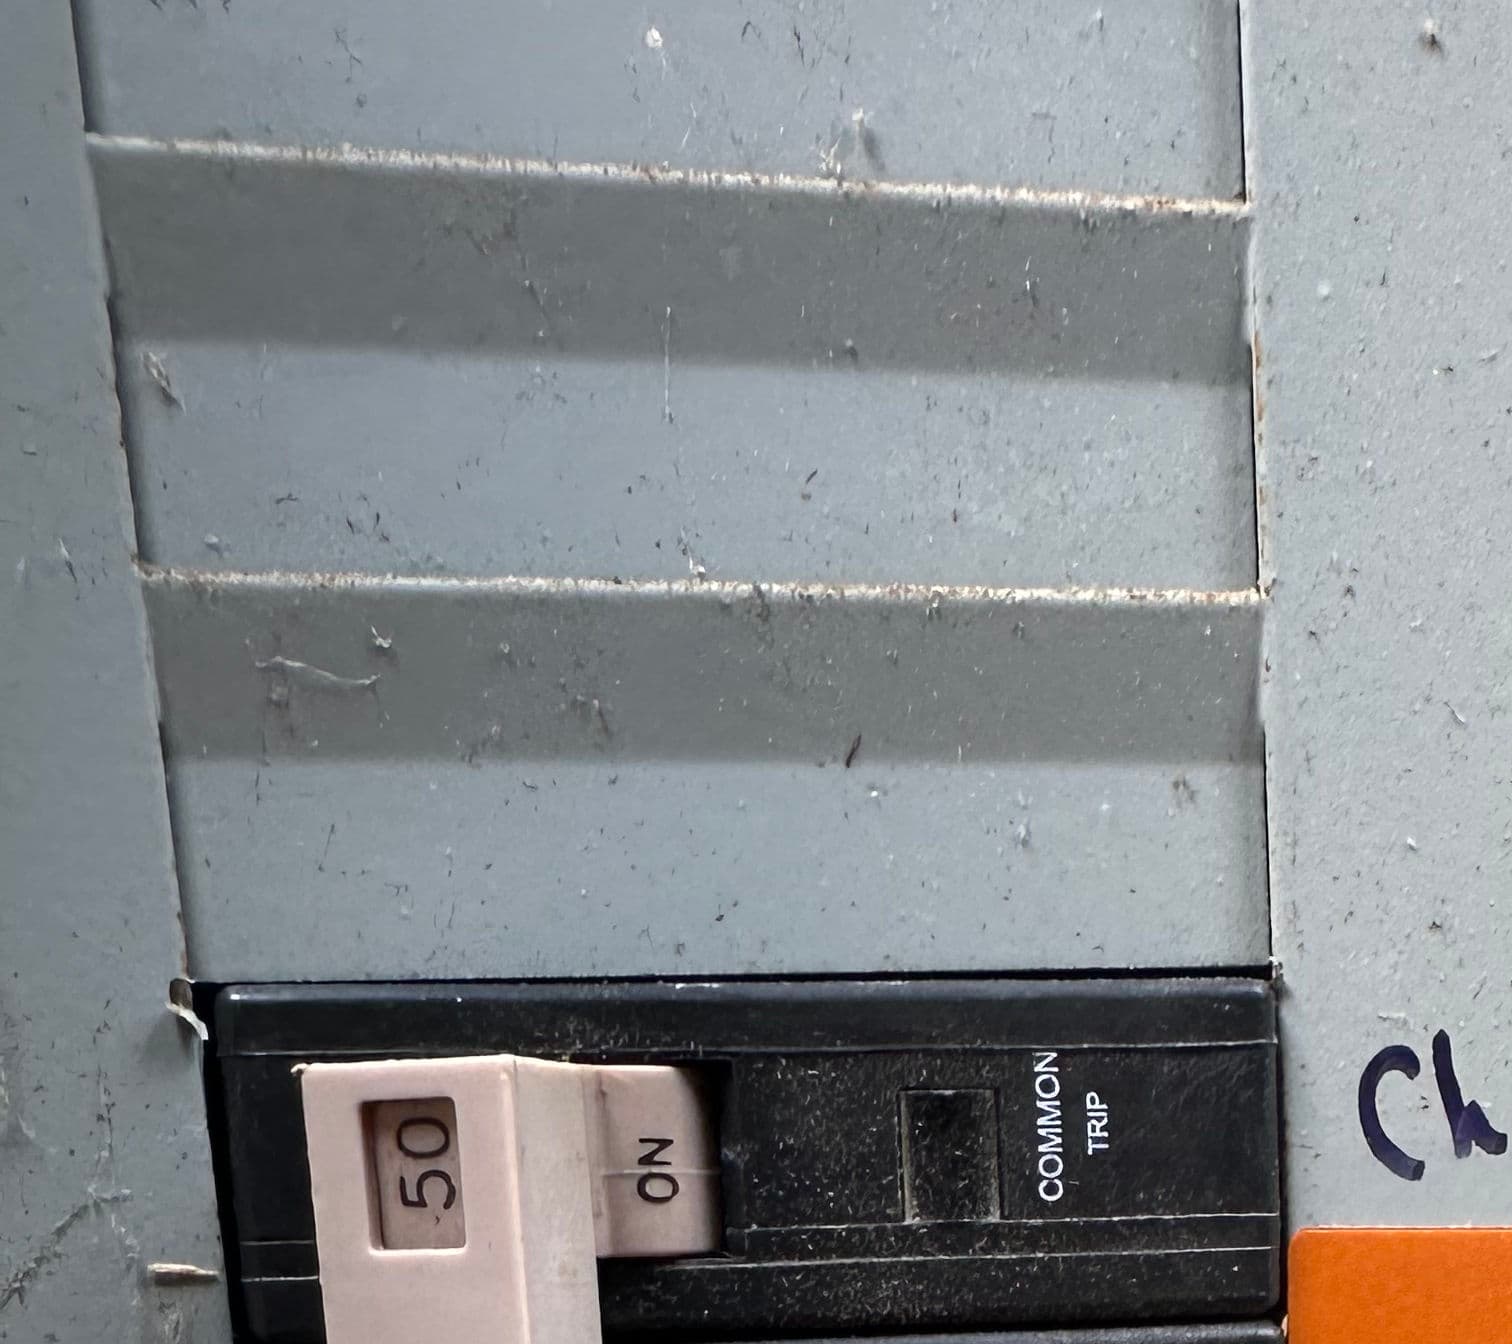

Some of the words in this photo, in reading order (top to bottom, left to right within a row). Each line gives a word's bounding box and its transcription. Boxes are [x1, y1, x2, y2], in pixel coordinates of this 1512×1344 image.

[397, 1116, 457, 1209] 50
[1033, 1051, 1064, 1201] COMMON
[1087, 1090, 1110, 1156] TRIP
[637, 1137, 680, 1203] ON
